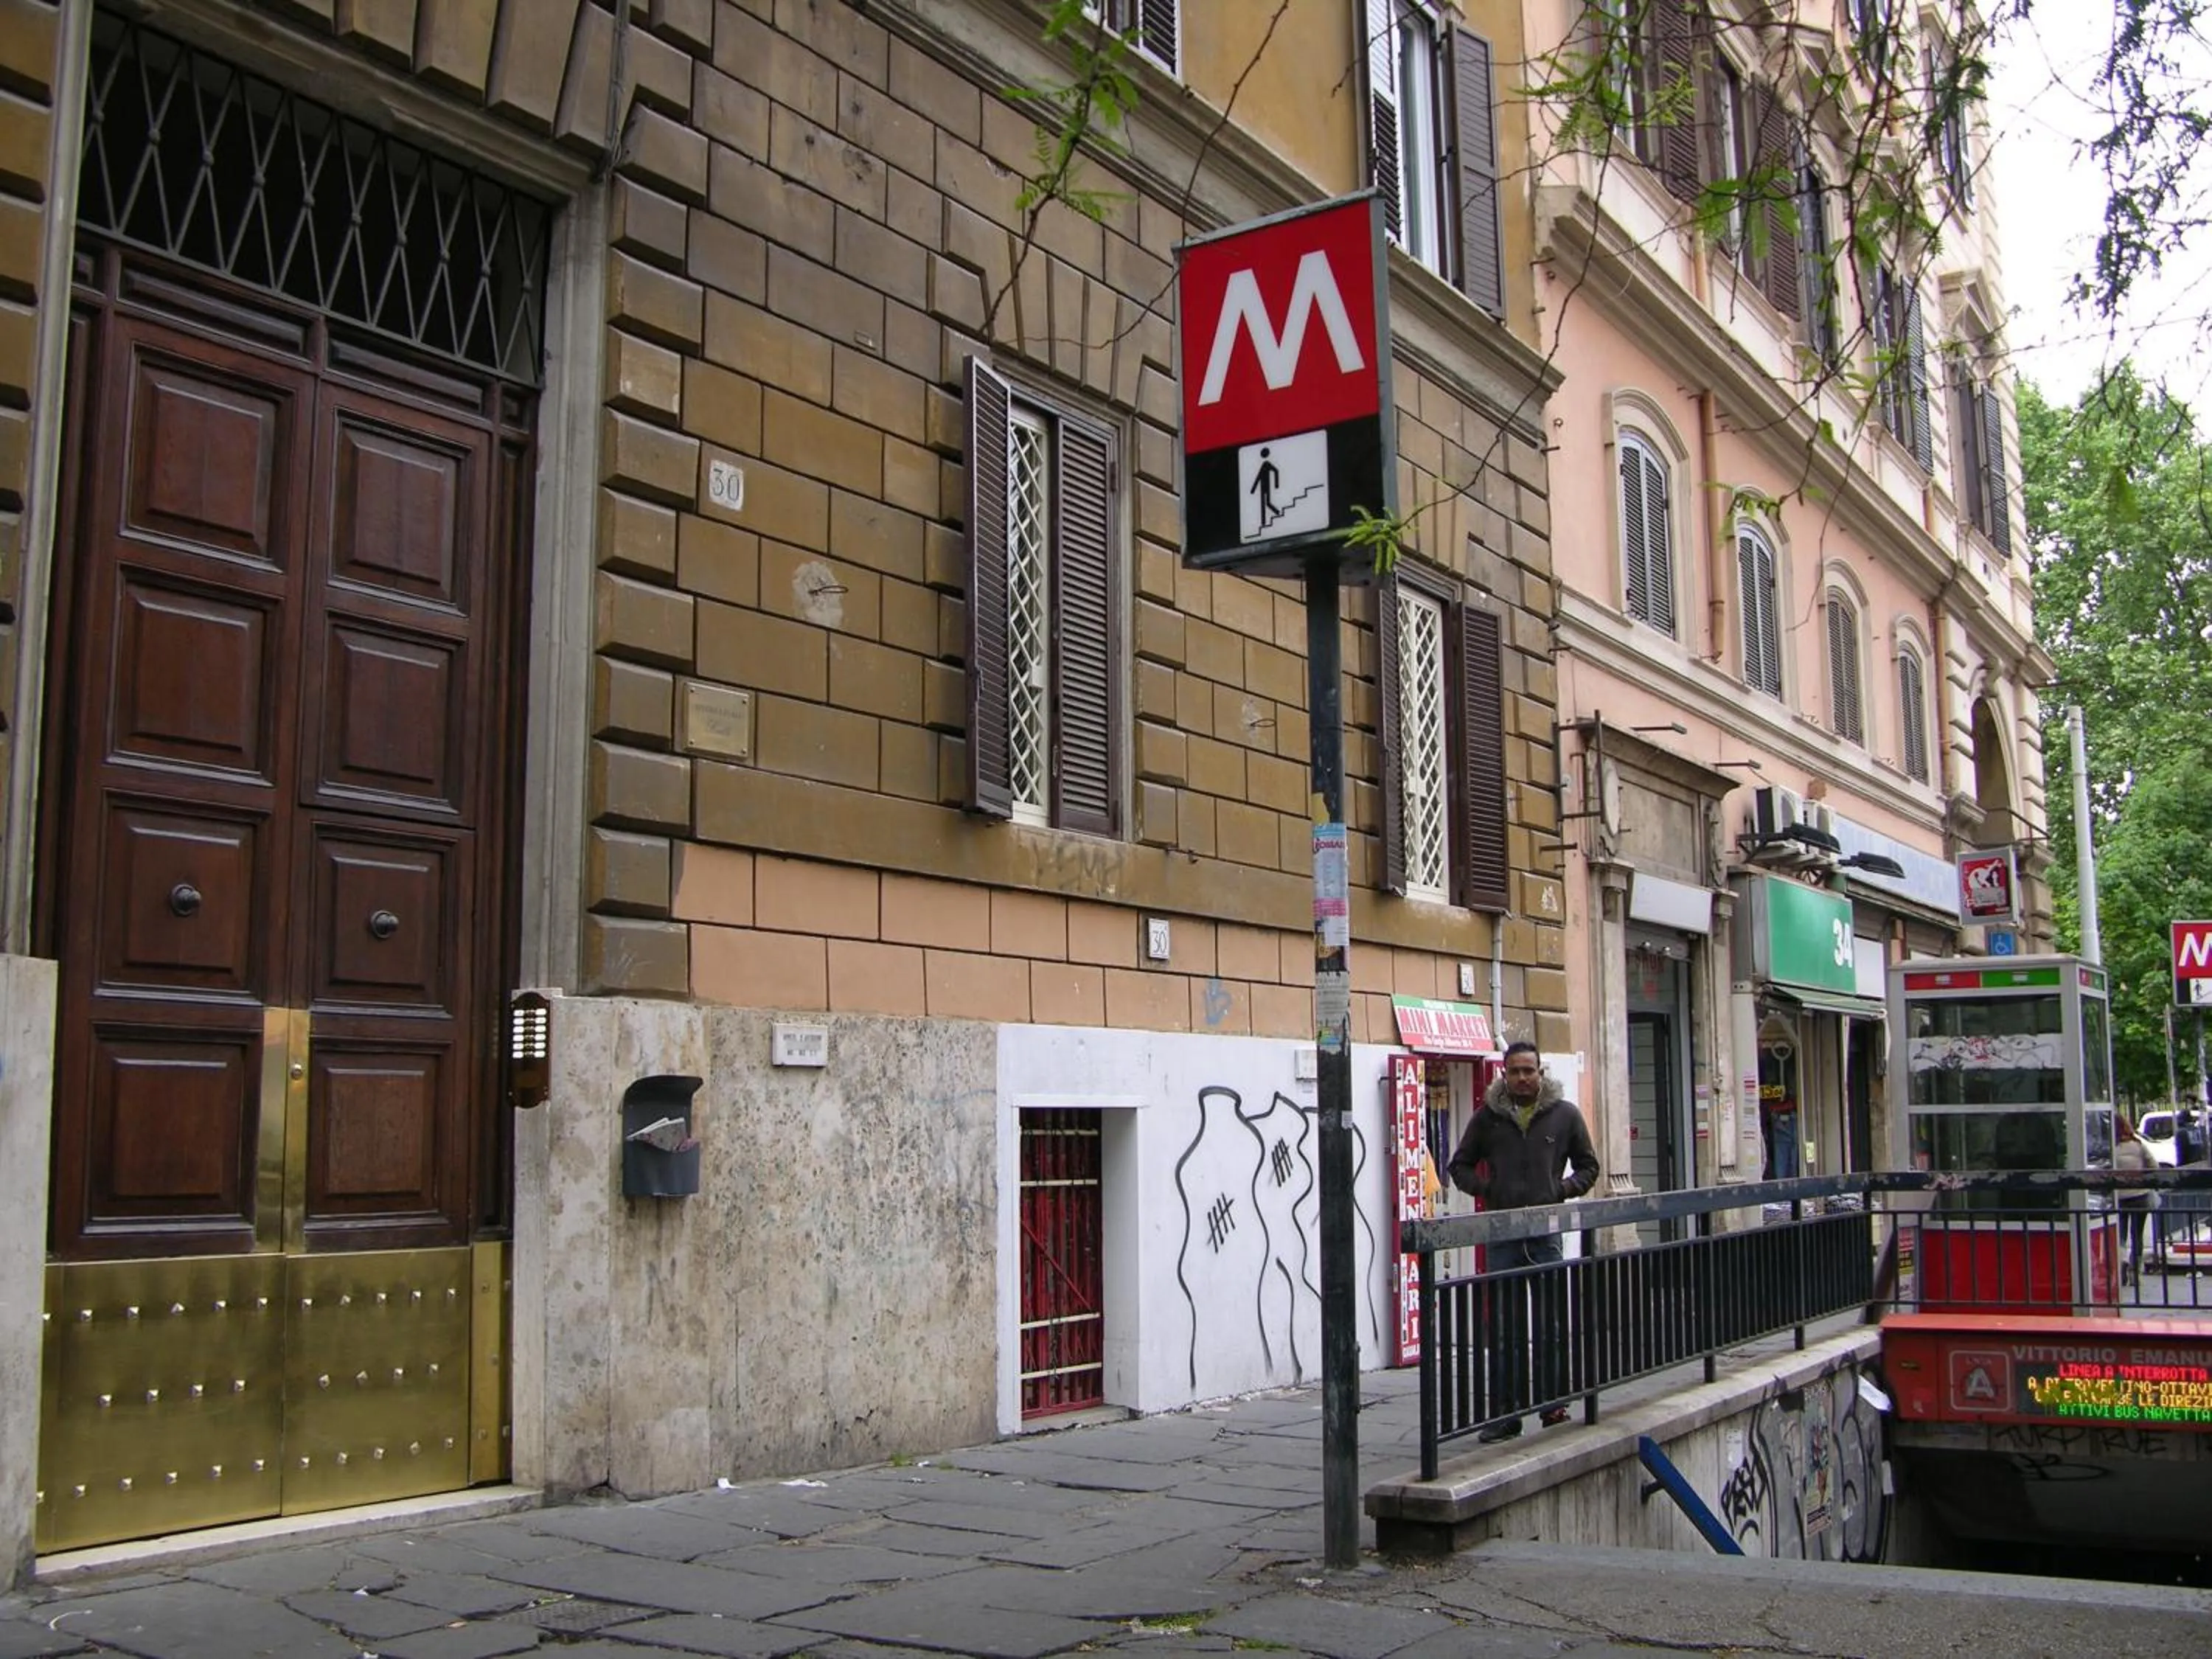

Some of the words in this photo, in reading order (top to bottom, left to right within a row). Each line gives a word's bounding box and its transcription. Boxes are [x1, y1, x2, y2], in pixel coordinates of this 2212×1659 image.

[1197, 249, 1366, 407] M
[713, 467, 740, 502] 30
[1152, 930, 1167, 954] 30
[1832, 918, 1853, 968] 34
[1436, 1009, 1490, 1040] MARKET
[1403, 1062, 1422, 1340] ALIMENARI
[2012, 1346, 2116, 1363] VITTORIO
[1966, 1368, 1995, 1398] A
[2059, 1363, 2101, 1378] LINEA
[2104, 1365, 2114, 1378] A
[2059, 1403, 2110, 1416] ATTIVI
[2114, 1405, 2139, 1419] BUS
[2144, 1407, 2211, 1422] NAVETTA
